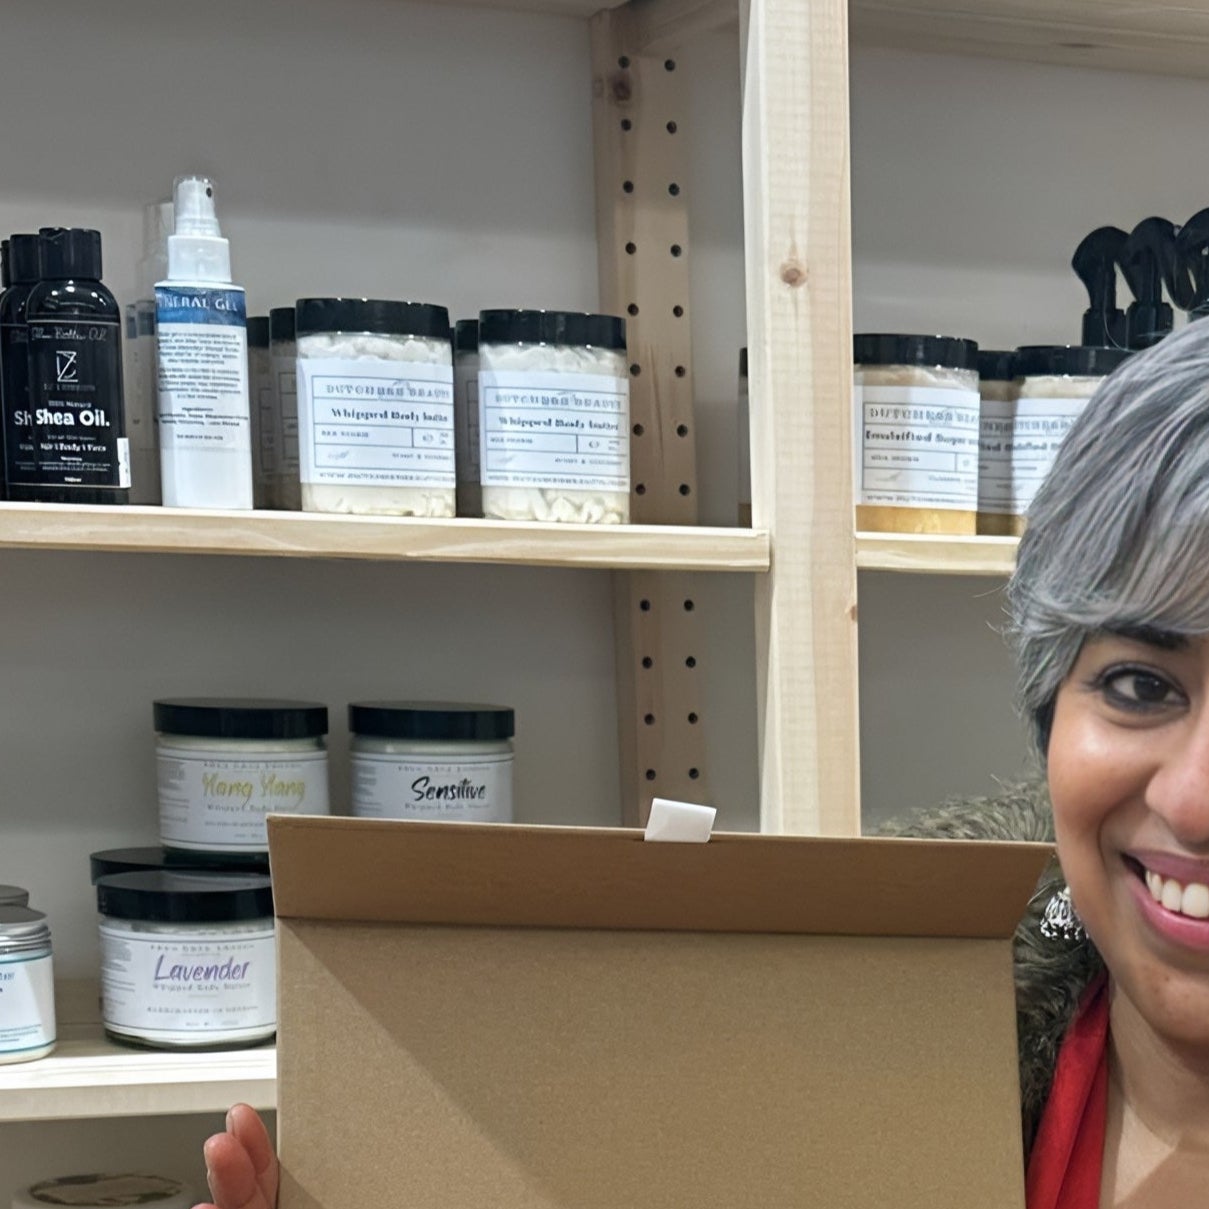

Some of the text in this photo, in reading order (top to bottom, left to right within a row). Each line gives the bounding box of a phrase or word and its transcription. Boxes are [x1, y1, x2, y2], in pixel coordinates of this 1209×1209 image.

[14, 410, 32, 426] Sh
[36, 408, 110, 427] Shea Oil.
[411, 776, 487, 801] Sensitive
[154, 954, 250, 982] Lavender
